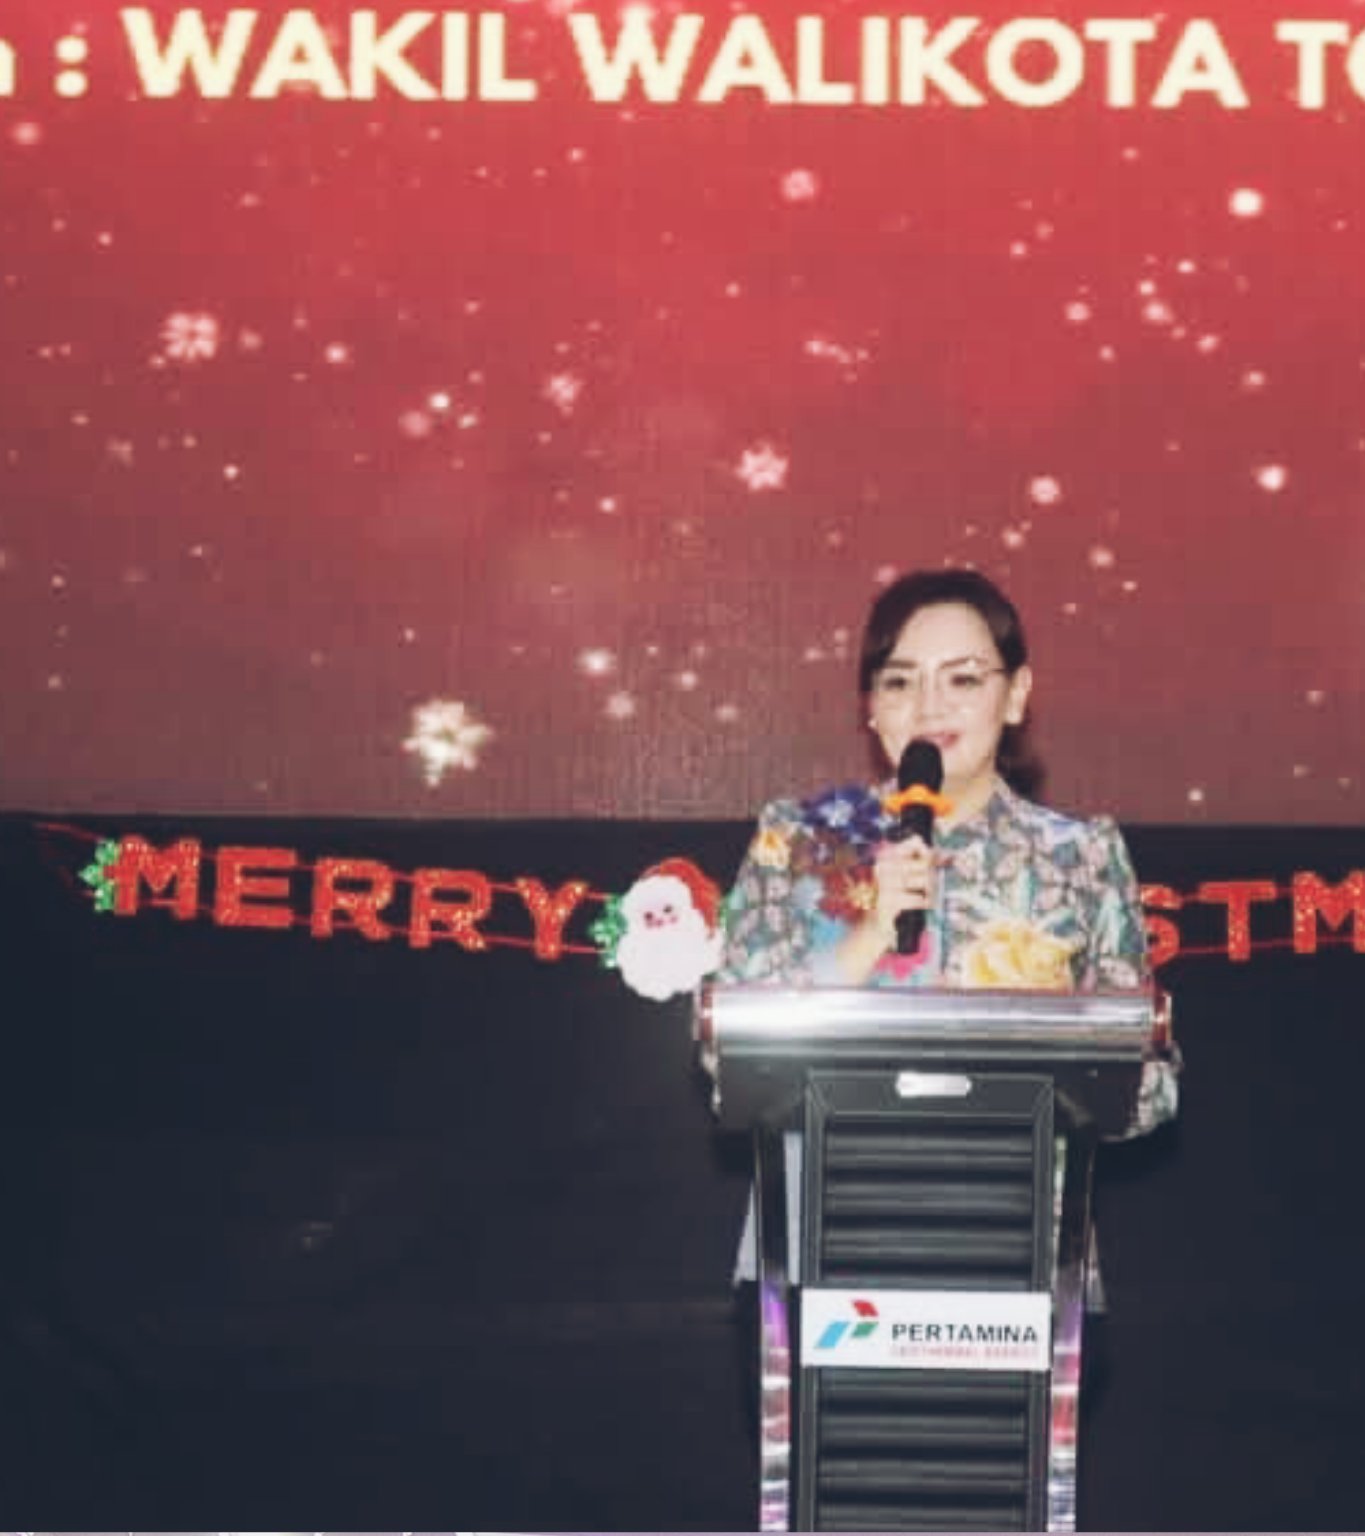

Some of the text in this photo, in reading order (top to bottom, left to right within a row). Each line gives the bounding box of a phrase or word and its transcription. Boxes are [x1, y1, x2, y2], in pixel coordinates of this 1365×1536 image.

[119, 7, 537, 102] WAKIL
[567, 10, 1250, 109] WALIKOTA
[113, 835, 589, 960] MERRY
[891, 1322, 1038, 1343] PERTAMINA
